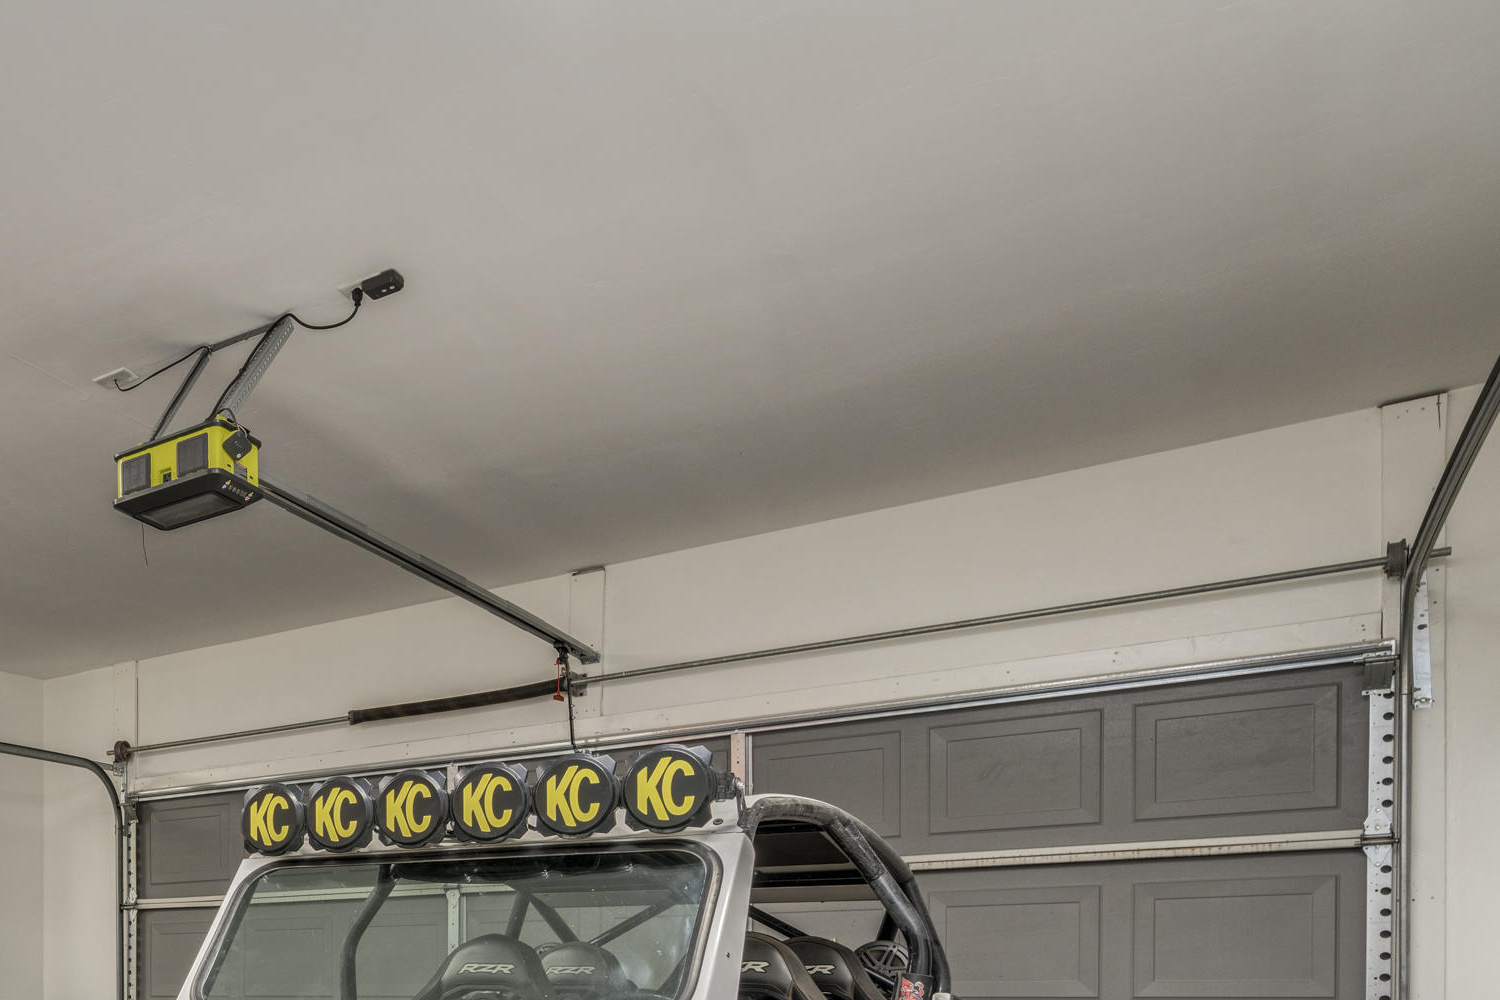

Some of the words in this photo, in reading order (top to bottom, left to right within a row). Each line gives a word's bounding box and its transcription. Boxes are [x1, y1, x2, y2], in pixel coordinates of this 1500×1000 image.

[315, 786, 358, 842] KC
[386, 780, 432, 838] KC
[462, 772, 513, 833] KC
[546, 764, 601, 828] KC
[636, 755, 696, 821] KC
[249, 792, 290, 847] KC
[458, 963, 516, 975] RZR
[545, 966, 597, 976] RZR
